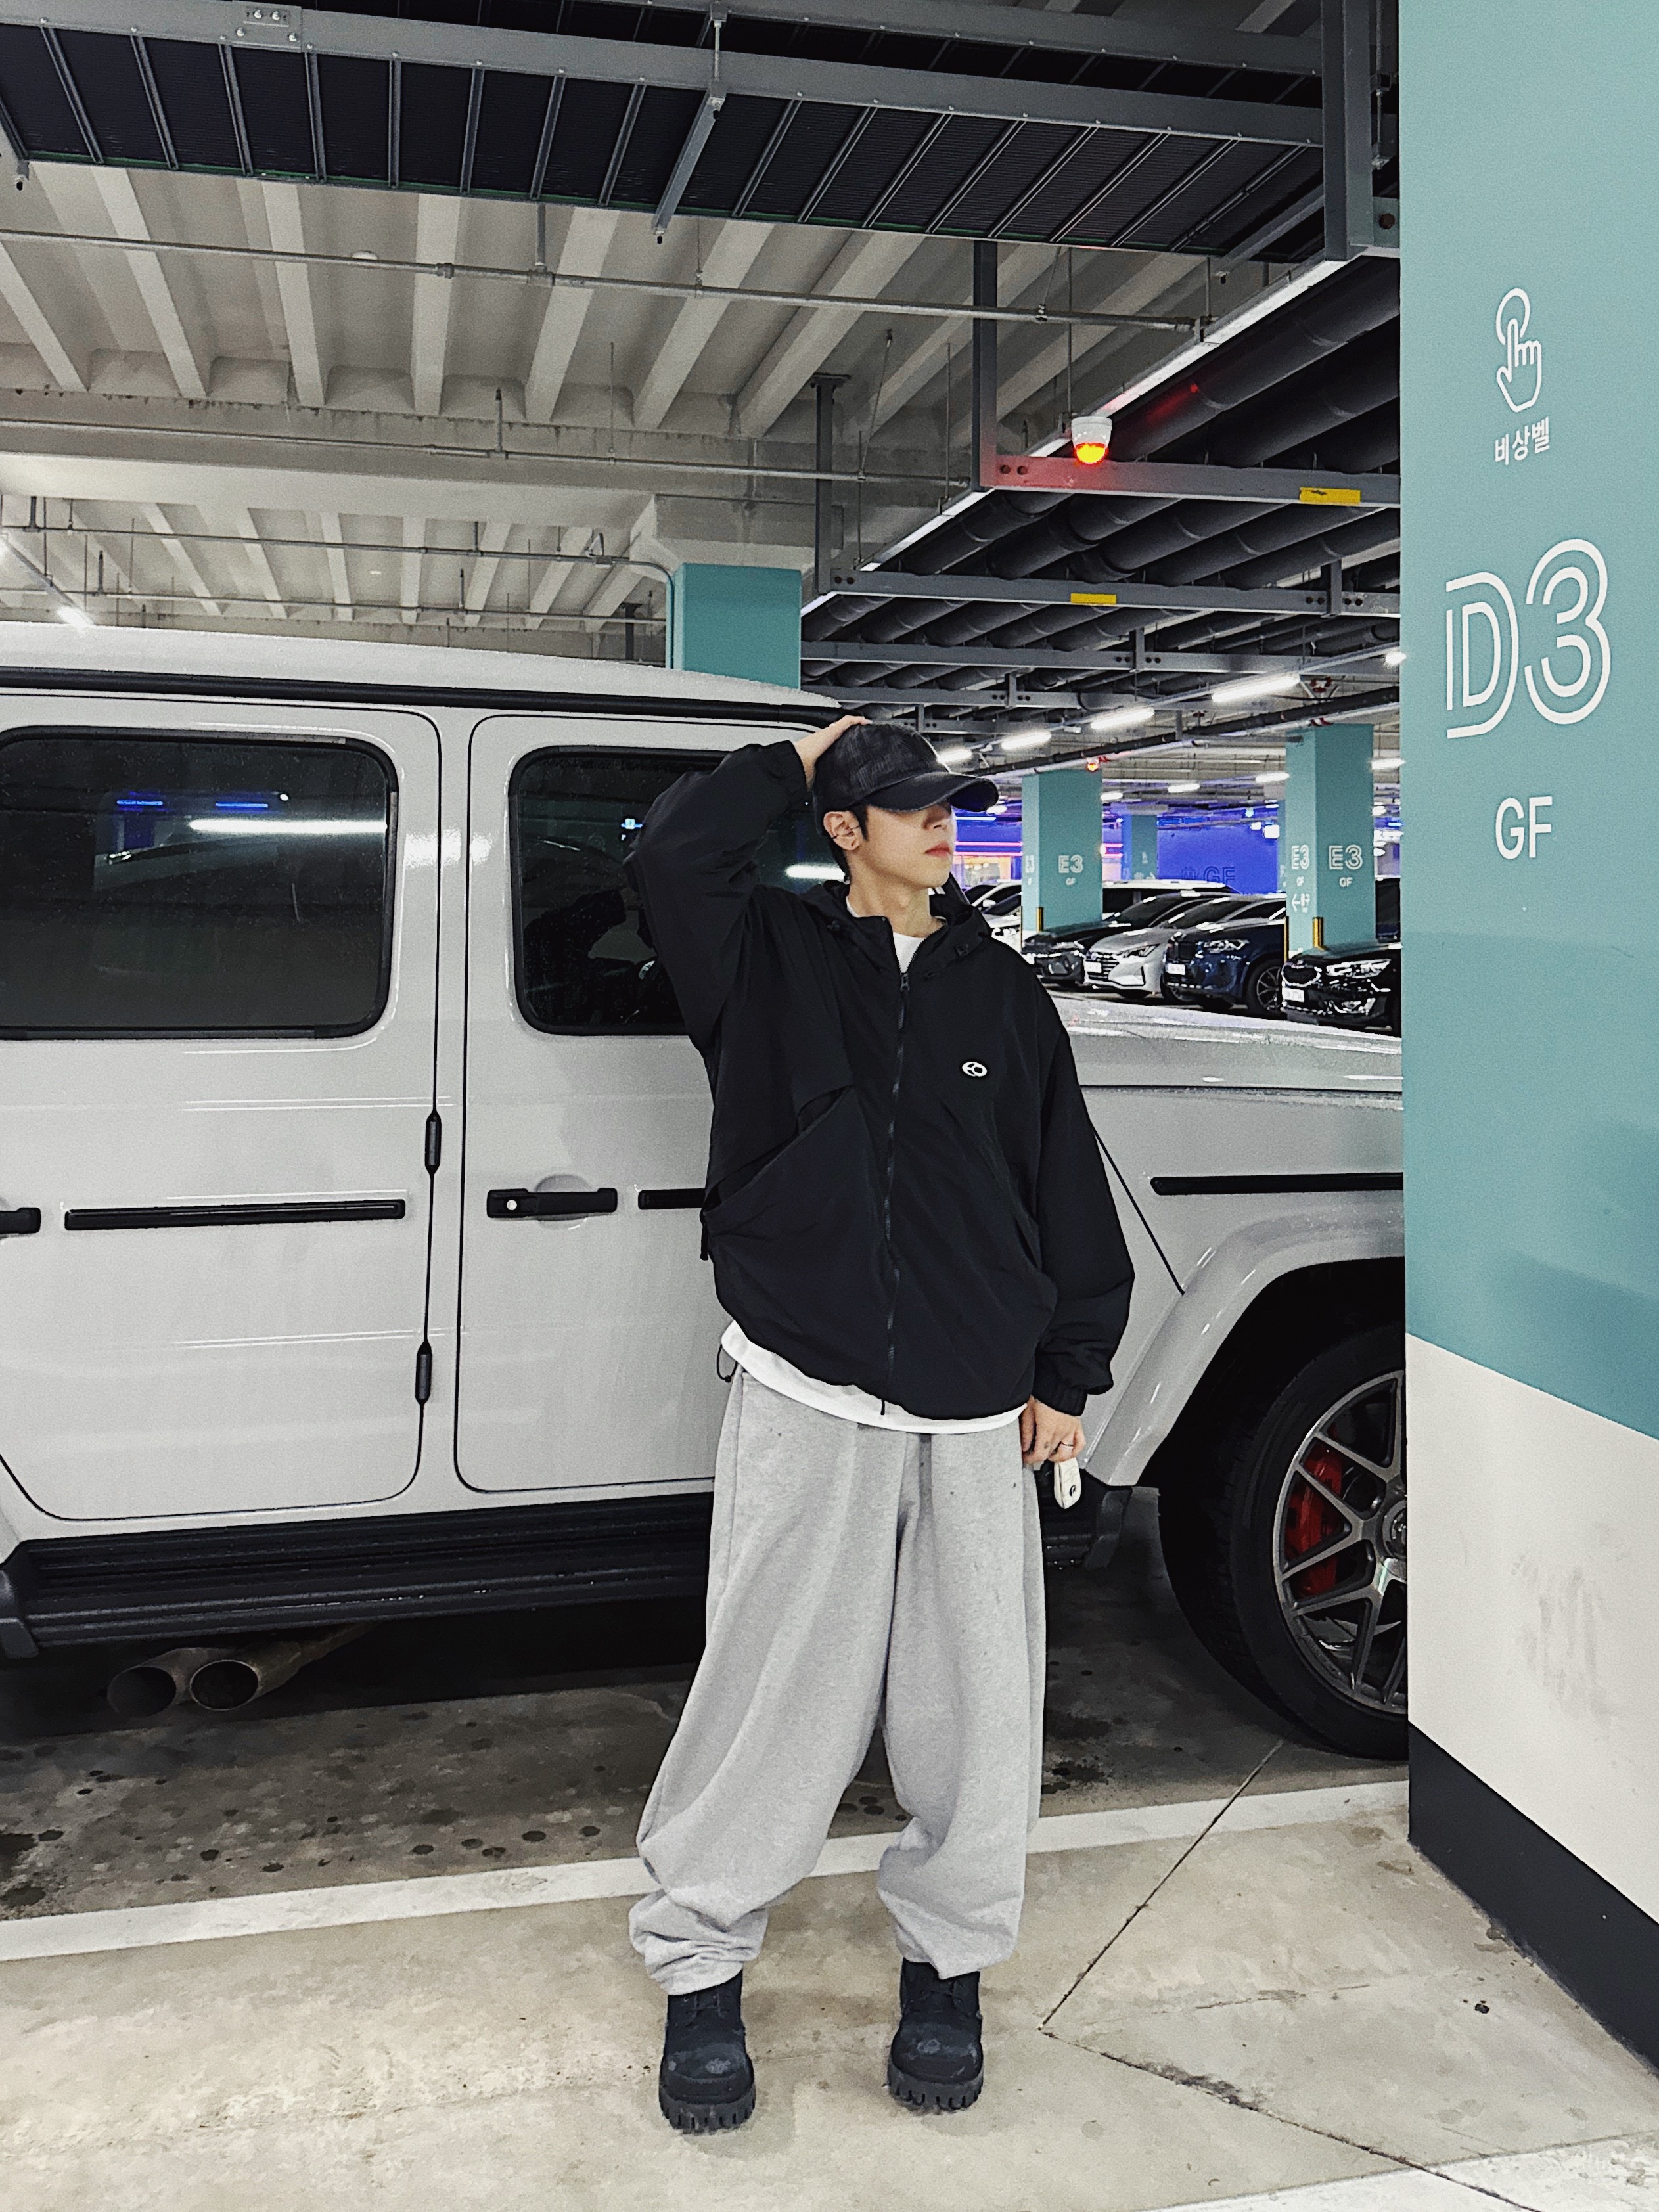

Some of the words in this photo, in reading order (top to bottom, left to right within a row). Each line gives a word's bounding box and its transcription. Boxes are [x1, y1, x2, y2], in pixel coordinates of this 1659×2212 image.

[1495, 417, 1550, 465] 비상벨
[1445, 538, 1610, 738] D3
[1495, 796, 1552, 859] GF
[1058, 854, 1083, 873] E3
[1291, 844, 1309, 870] E3
[1329, 844, 1363, 870] E3
[1339, 876, 1353, 887] GF
